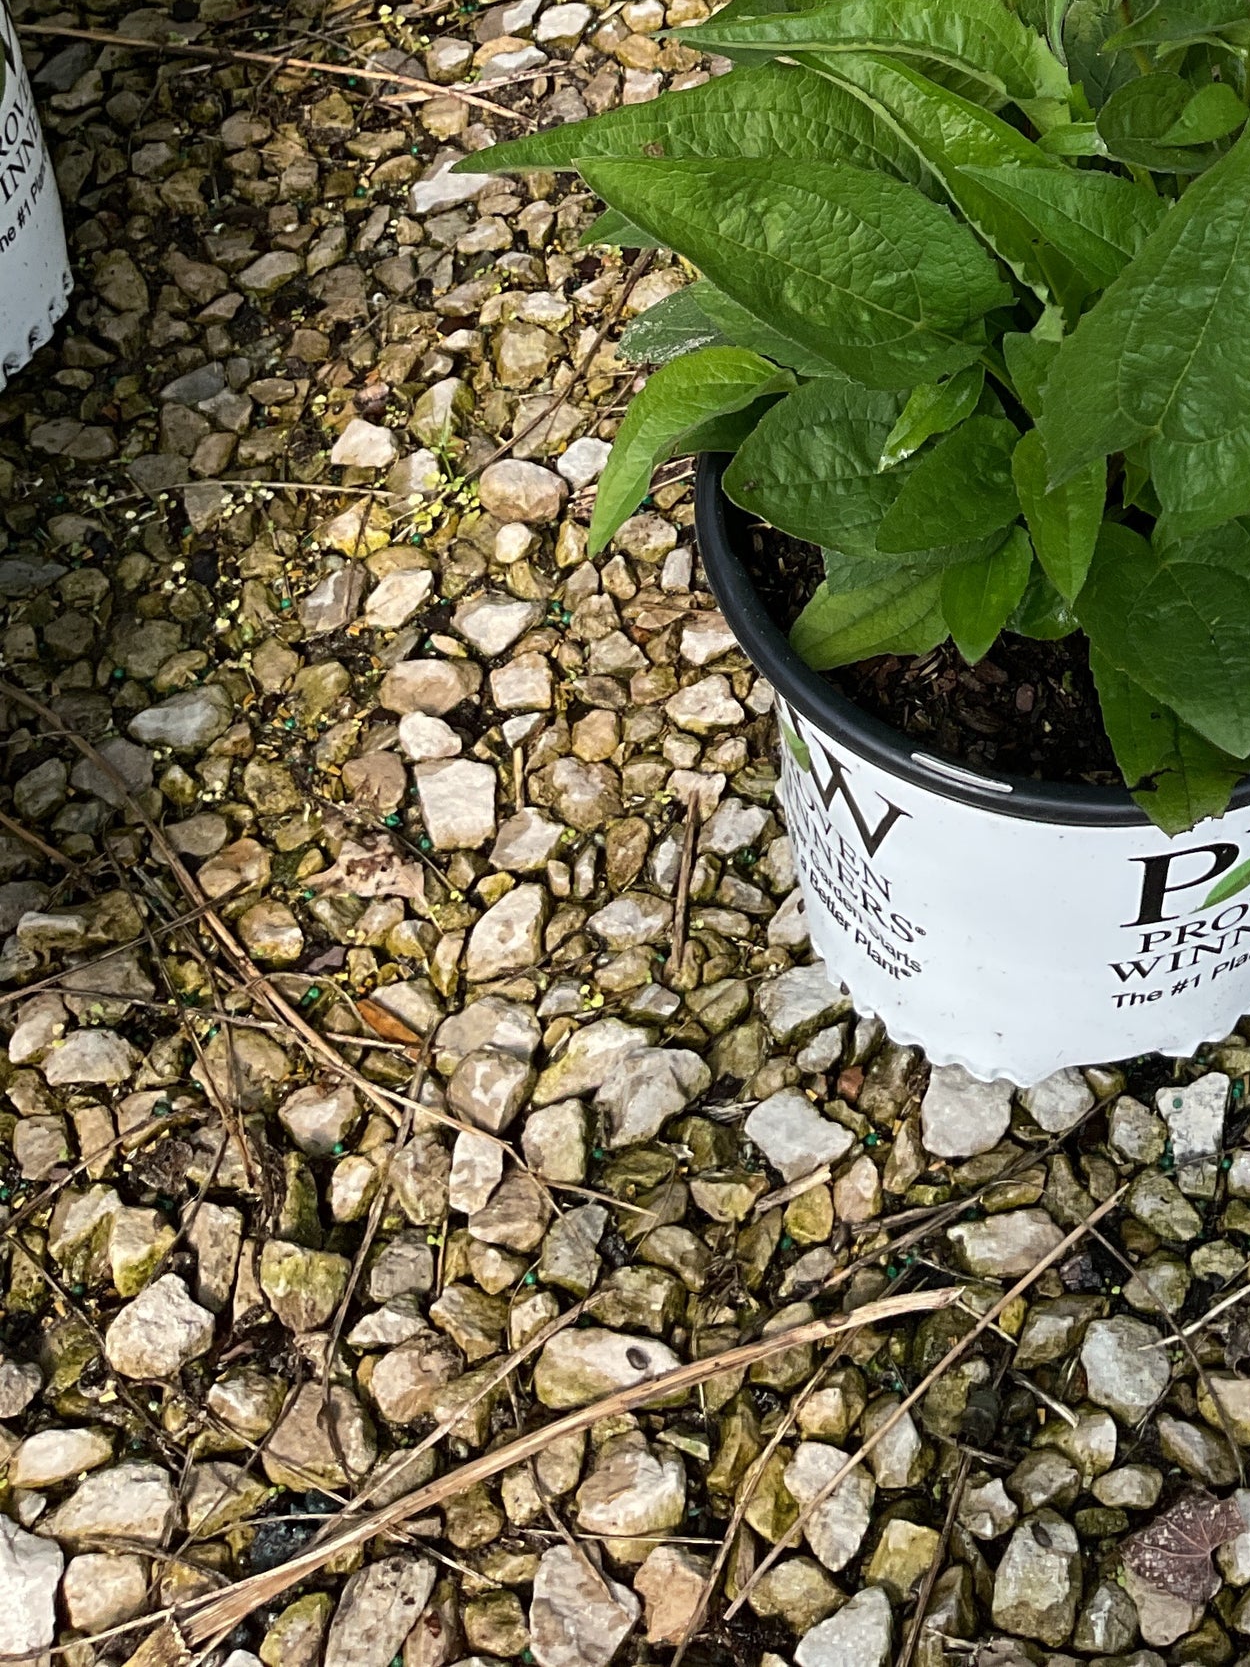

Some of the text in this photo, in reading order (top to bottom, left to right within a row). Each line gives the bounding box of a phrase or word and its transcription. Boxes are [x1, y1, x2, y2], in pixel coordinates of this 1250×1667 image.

[17, 198, 32, 229] #1
[809, 867, 852, 932] Better
[810, 849, 923, 974] Garden Starts
[1112, 990, 1163, 1008] The
[1171, 973, 1201, 996] #1
